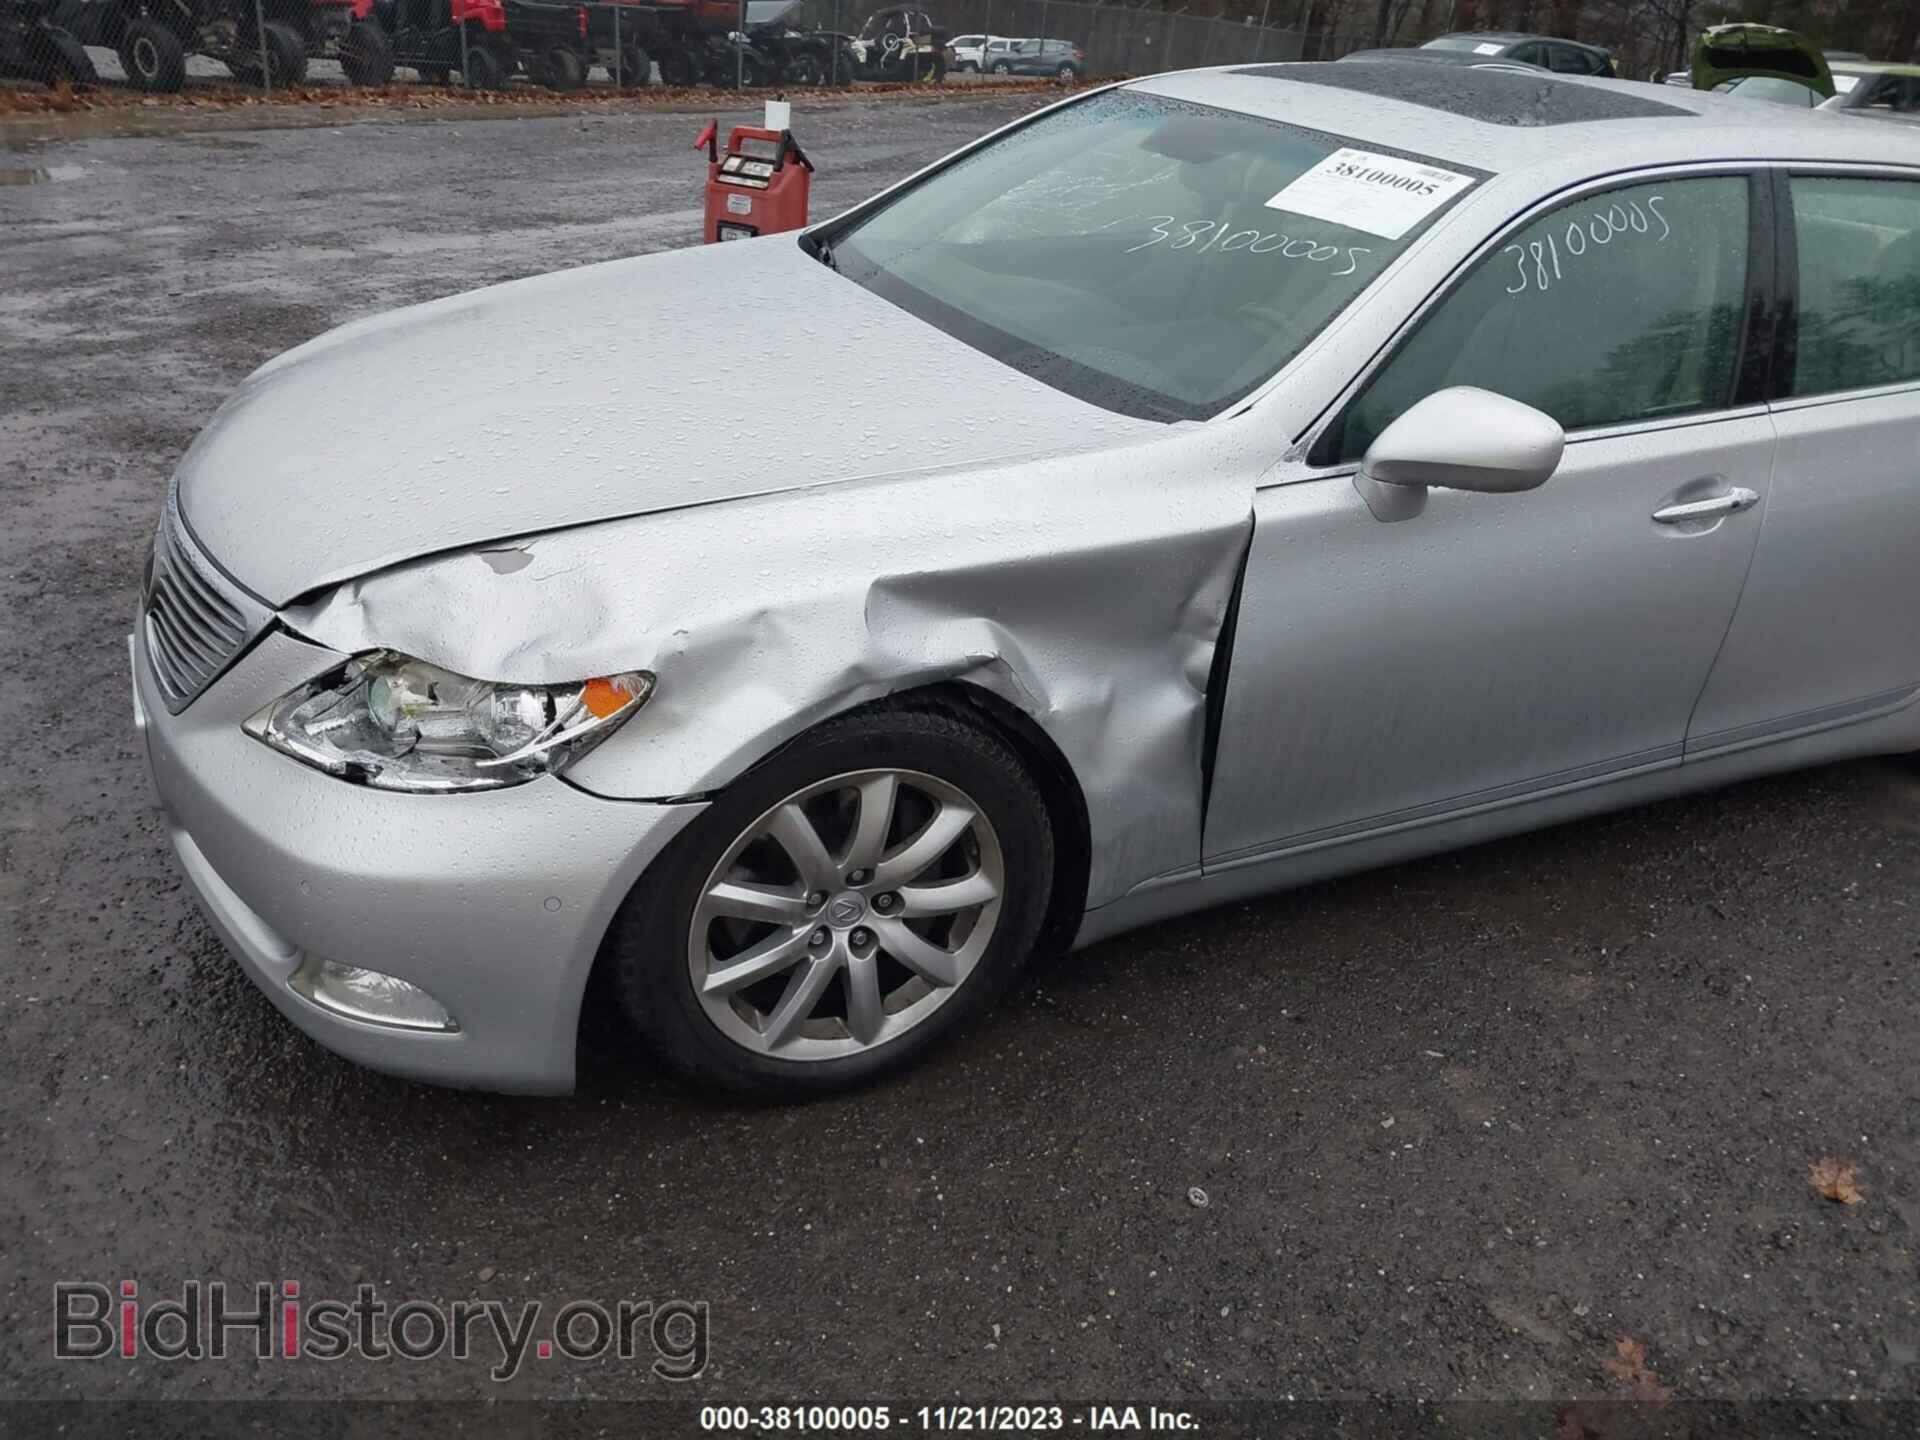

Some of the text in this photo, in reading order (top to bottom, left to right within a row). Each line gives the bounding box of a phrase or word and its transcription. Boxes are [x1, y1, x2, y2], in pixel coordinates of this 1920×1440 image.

[1326, 162, 1440, 196] 38100005
[1124, 215, 1371, 276] 38100005
[1503, 195, 1670, 294] 38100005
